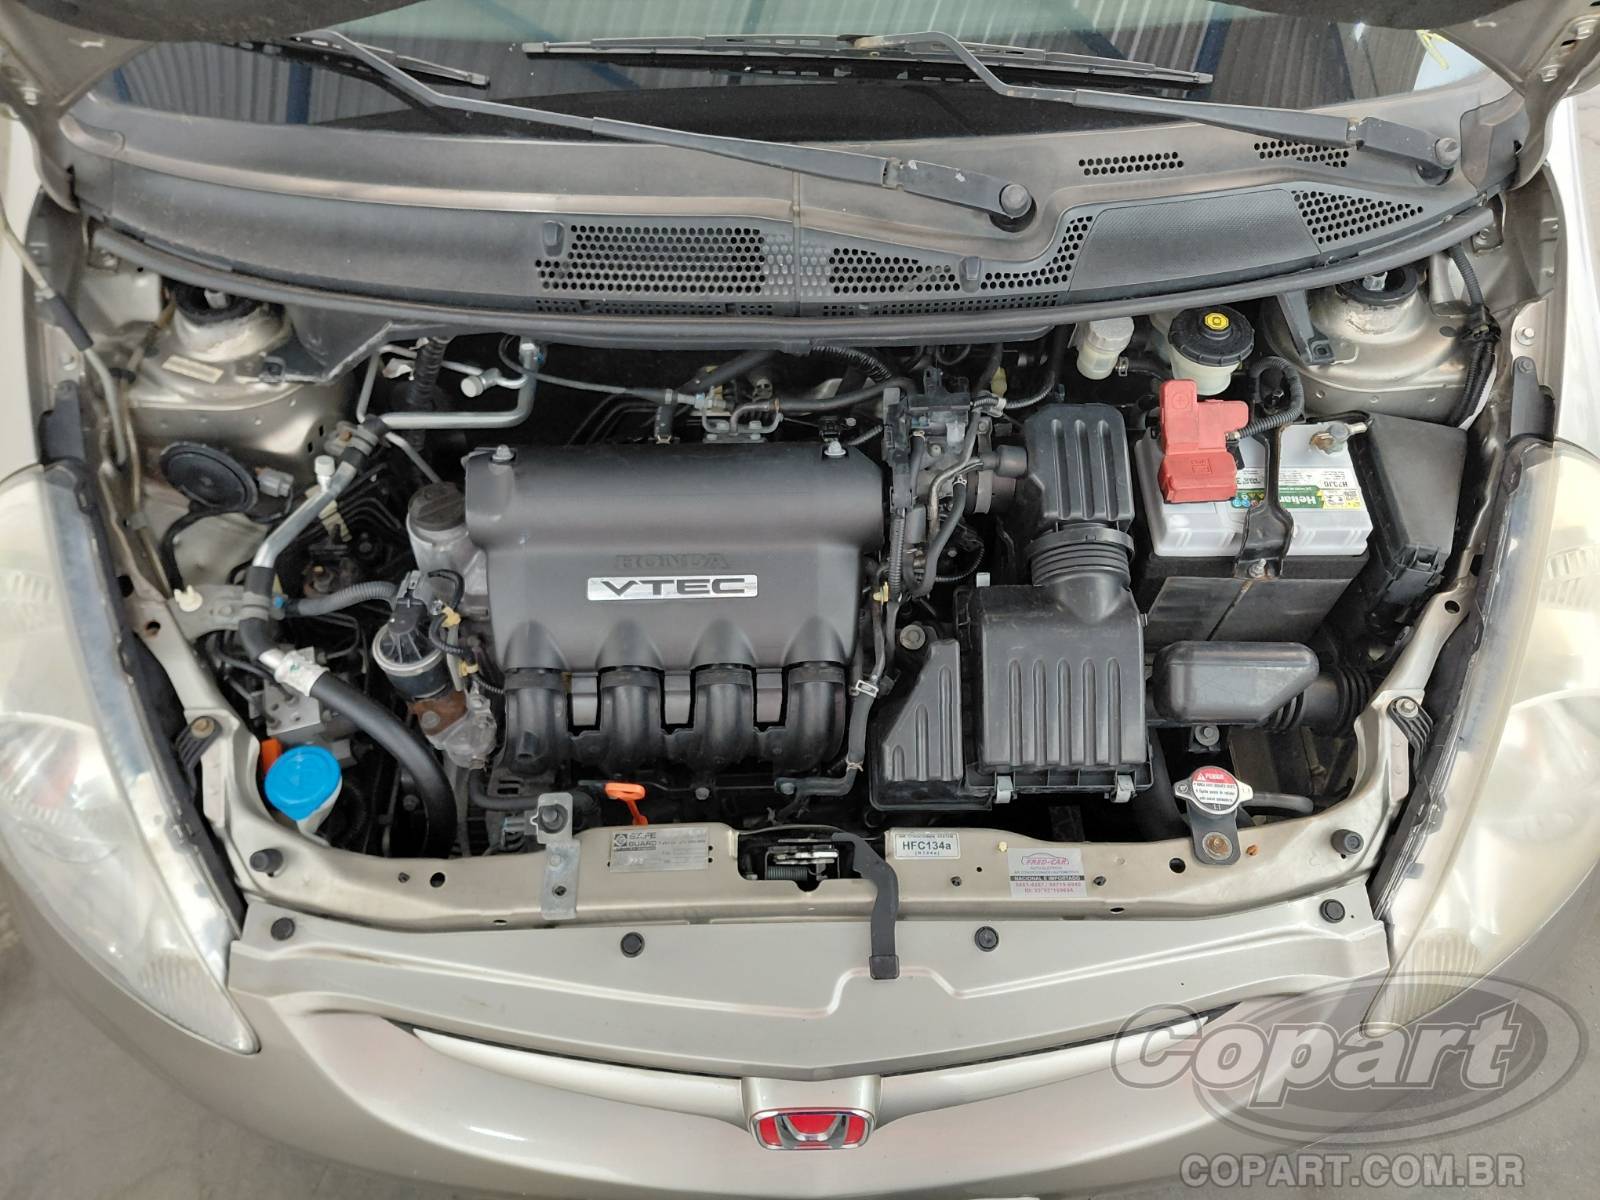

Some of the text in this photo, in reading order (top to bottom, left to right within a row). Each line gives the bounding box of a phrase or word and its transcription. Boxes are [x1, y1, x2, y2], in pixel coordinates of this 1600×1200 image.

[614, 553, 730, 569] HONDA
[602, 578, 745, 597] VTEC
[902, 841, 952, 850] HFC134a
